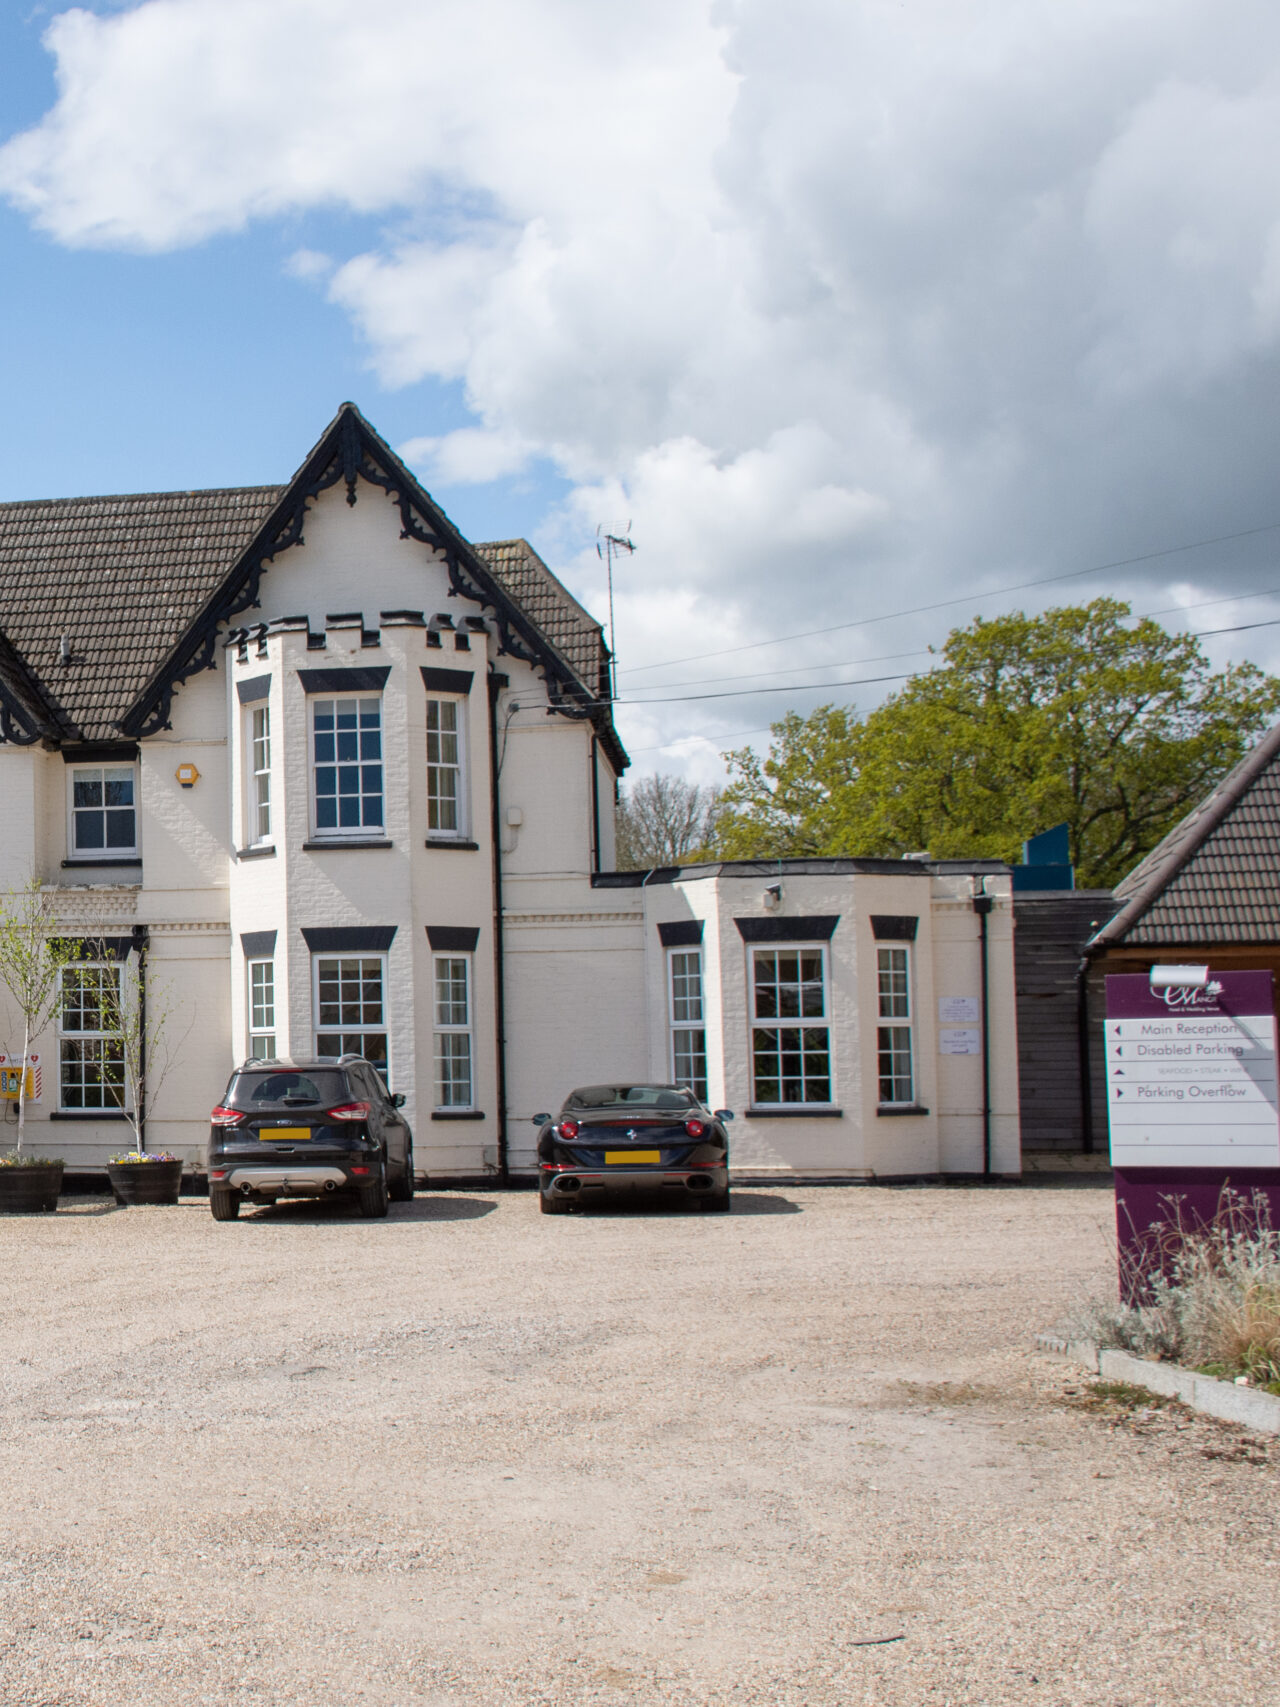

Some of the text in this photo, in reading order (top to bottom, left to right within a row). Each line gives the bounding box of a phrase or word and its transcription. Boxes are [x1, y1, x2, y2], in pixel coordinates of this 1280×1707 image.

[1141, 1023, 1240, 1036] Main Reception
[1137, 1043, 1244, 1057] Disabled Parking
[1137, 1084, 1247, 1100] Parking Overflow
